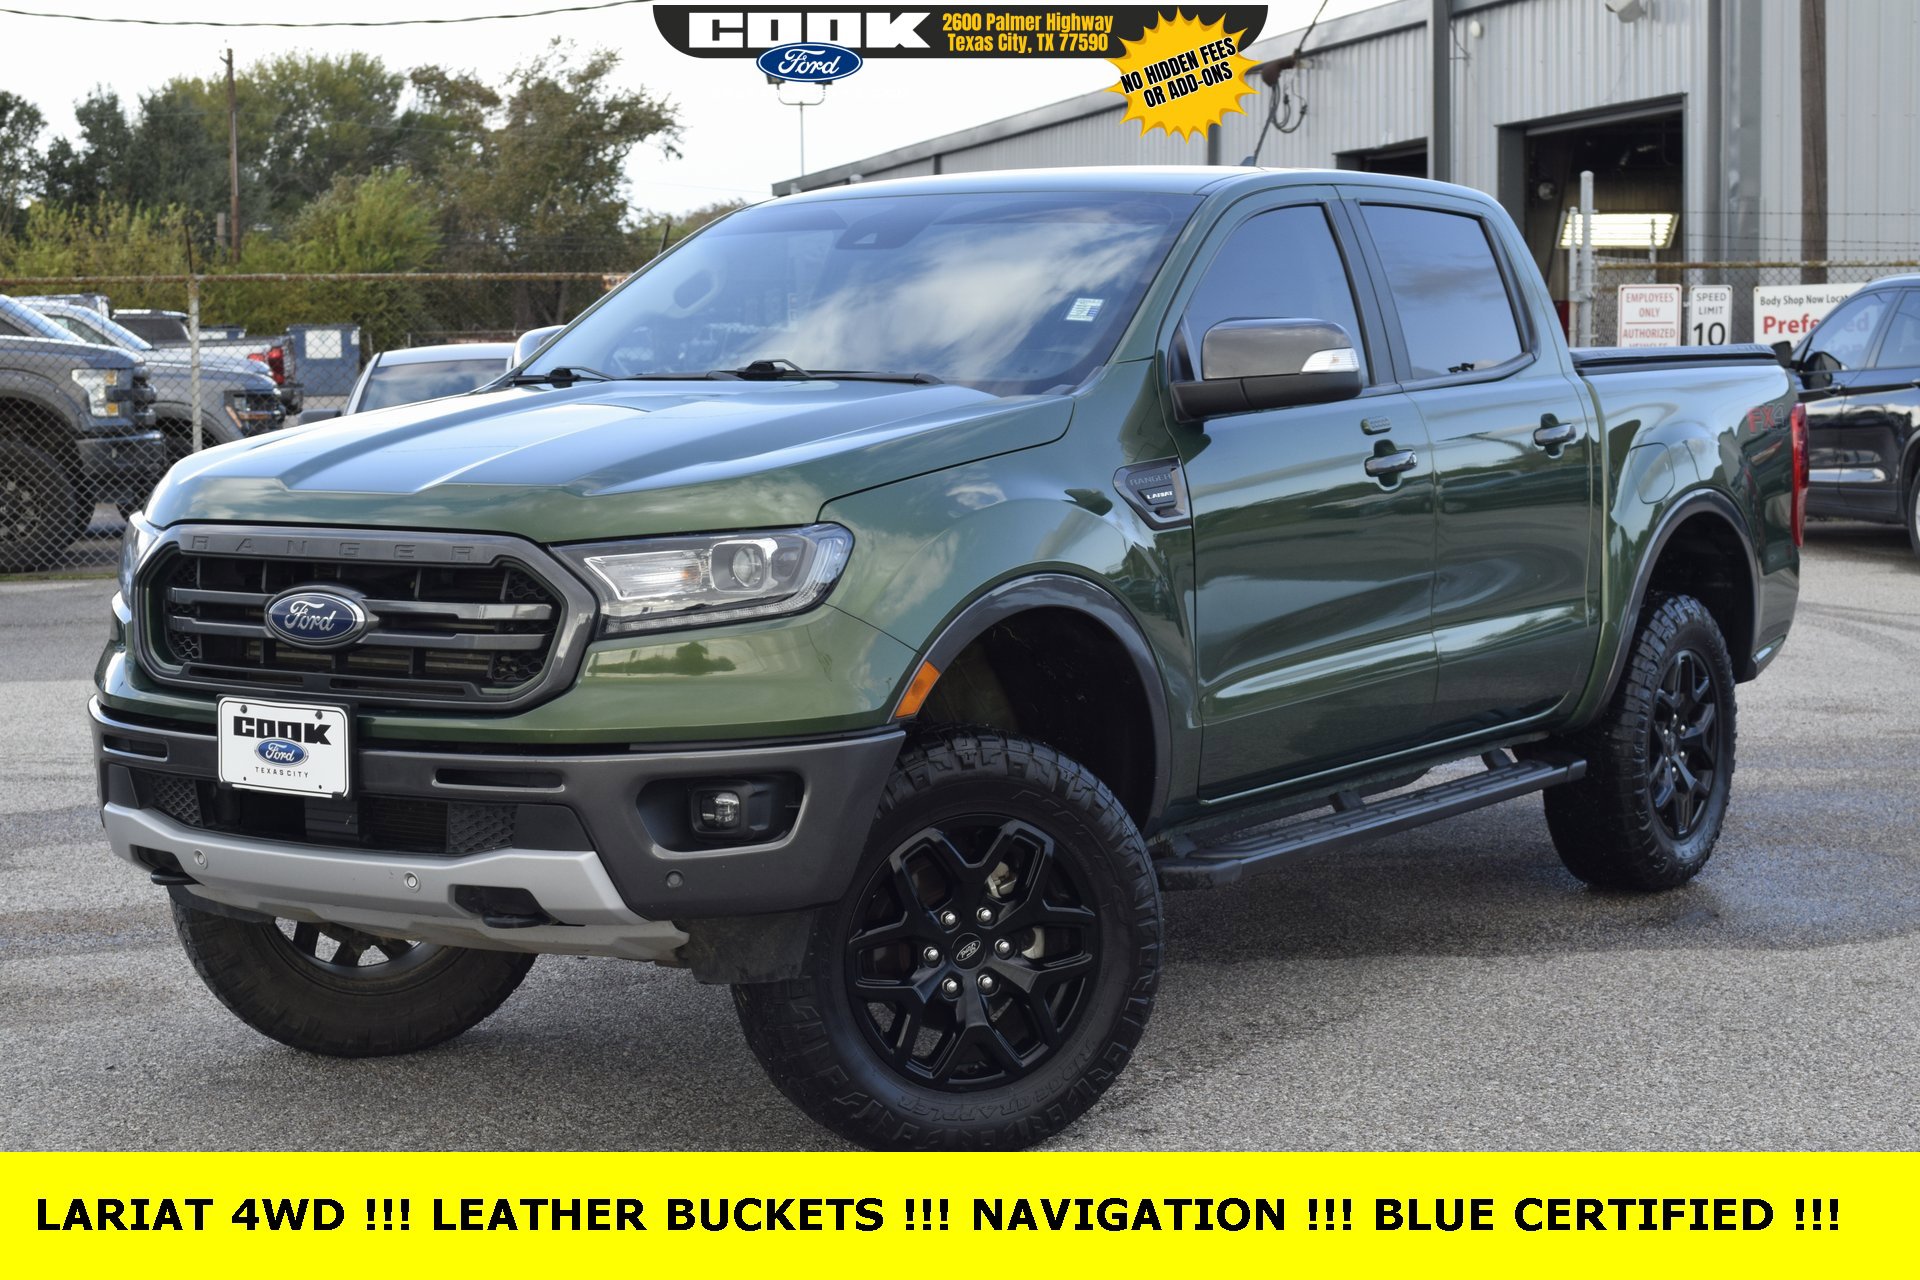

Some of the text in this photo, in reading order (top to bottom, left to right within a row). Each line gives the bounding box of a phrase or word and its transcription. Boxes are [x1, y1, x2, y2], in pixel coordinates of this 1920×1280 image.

[1626, 293, 1674, 303] EMPLOYEES
[1696, 292, 1727, 302] SPEED
[1760, 295, 1781, 307] Body
[1783, 294, 1804, 307] Shop
[1806, 294, 1824, 305] Now
[1639, 307, 1660, 318] ONLY
[1698, 306, 1723, 316] LIMIT
[1623, 328, 1676, 338] AUTHORIZED
[1693, 322, 1726, 346] 10
[1747, 403, 1785, 436] FX4
[1129, 473, 1172, 486] RANGER
[191, 536, 475, 561] RANGER
[284, 599, 337, 632] Ford
[233, 715, 332, 746] COOK
[264, 742, 296, 762] Ford
[255, 766, 309, 779] TEXAS CITY
